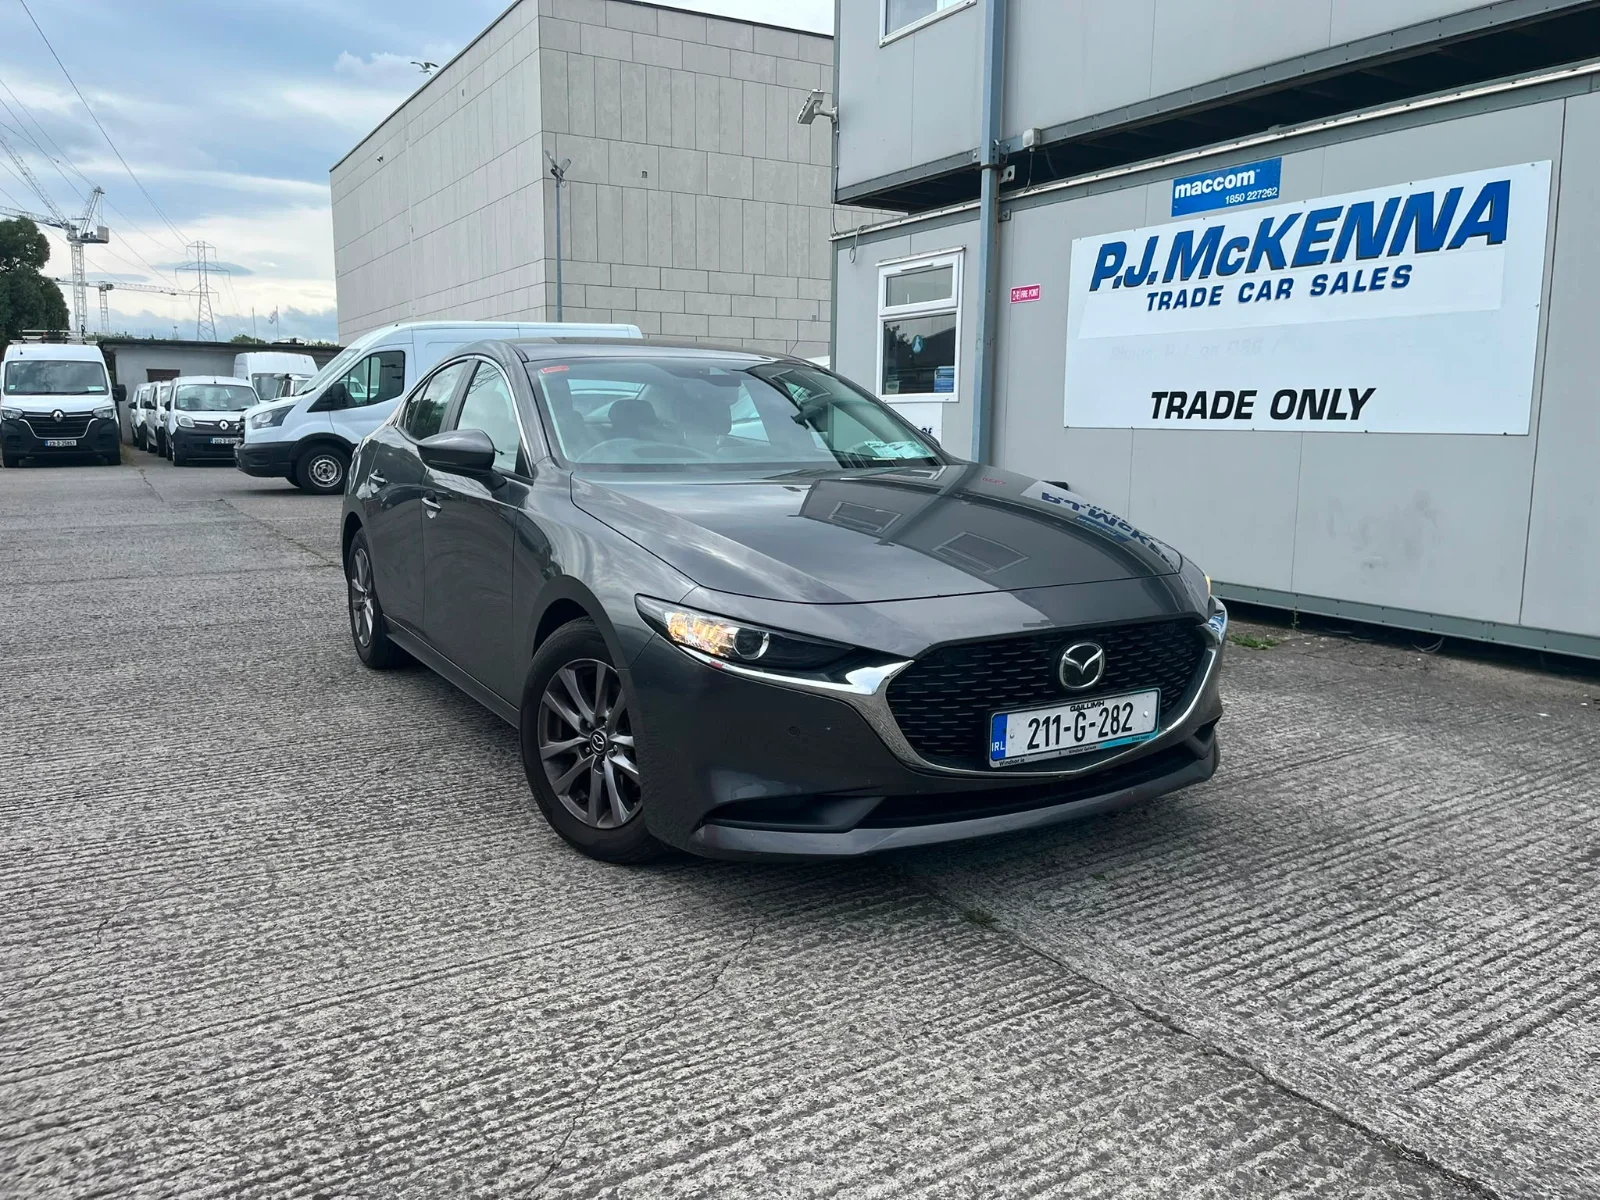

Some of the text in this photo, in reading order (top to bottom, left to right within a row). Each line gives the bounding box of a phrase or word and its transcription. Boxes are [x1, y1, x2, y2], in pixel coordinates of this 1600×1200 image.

[1175, 170, 1255, 198] maccom
[1225, 187, 1278, 204] 1850 227262
[1147, 264, 1413, 311] TRADE CAR SALES
[1151, 388, 1377, 420] TRADE ONLY
[1027, 702, 1134, 750] 211-G-282
[991, 741, 1006, 752] IRL
